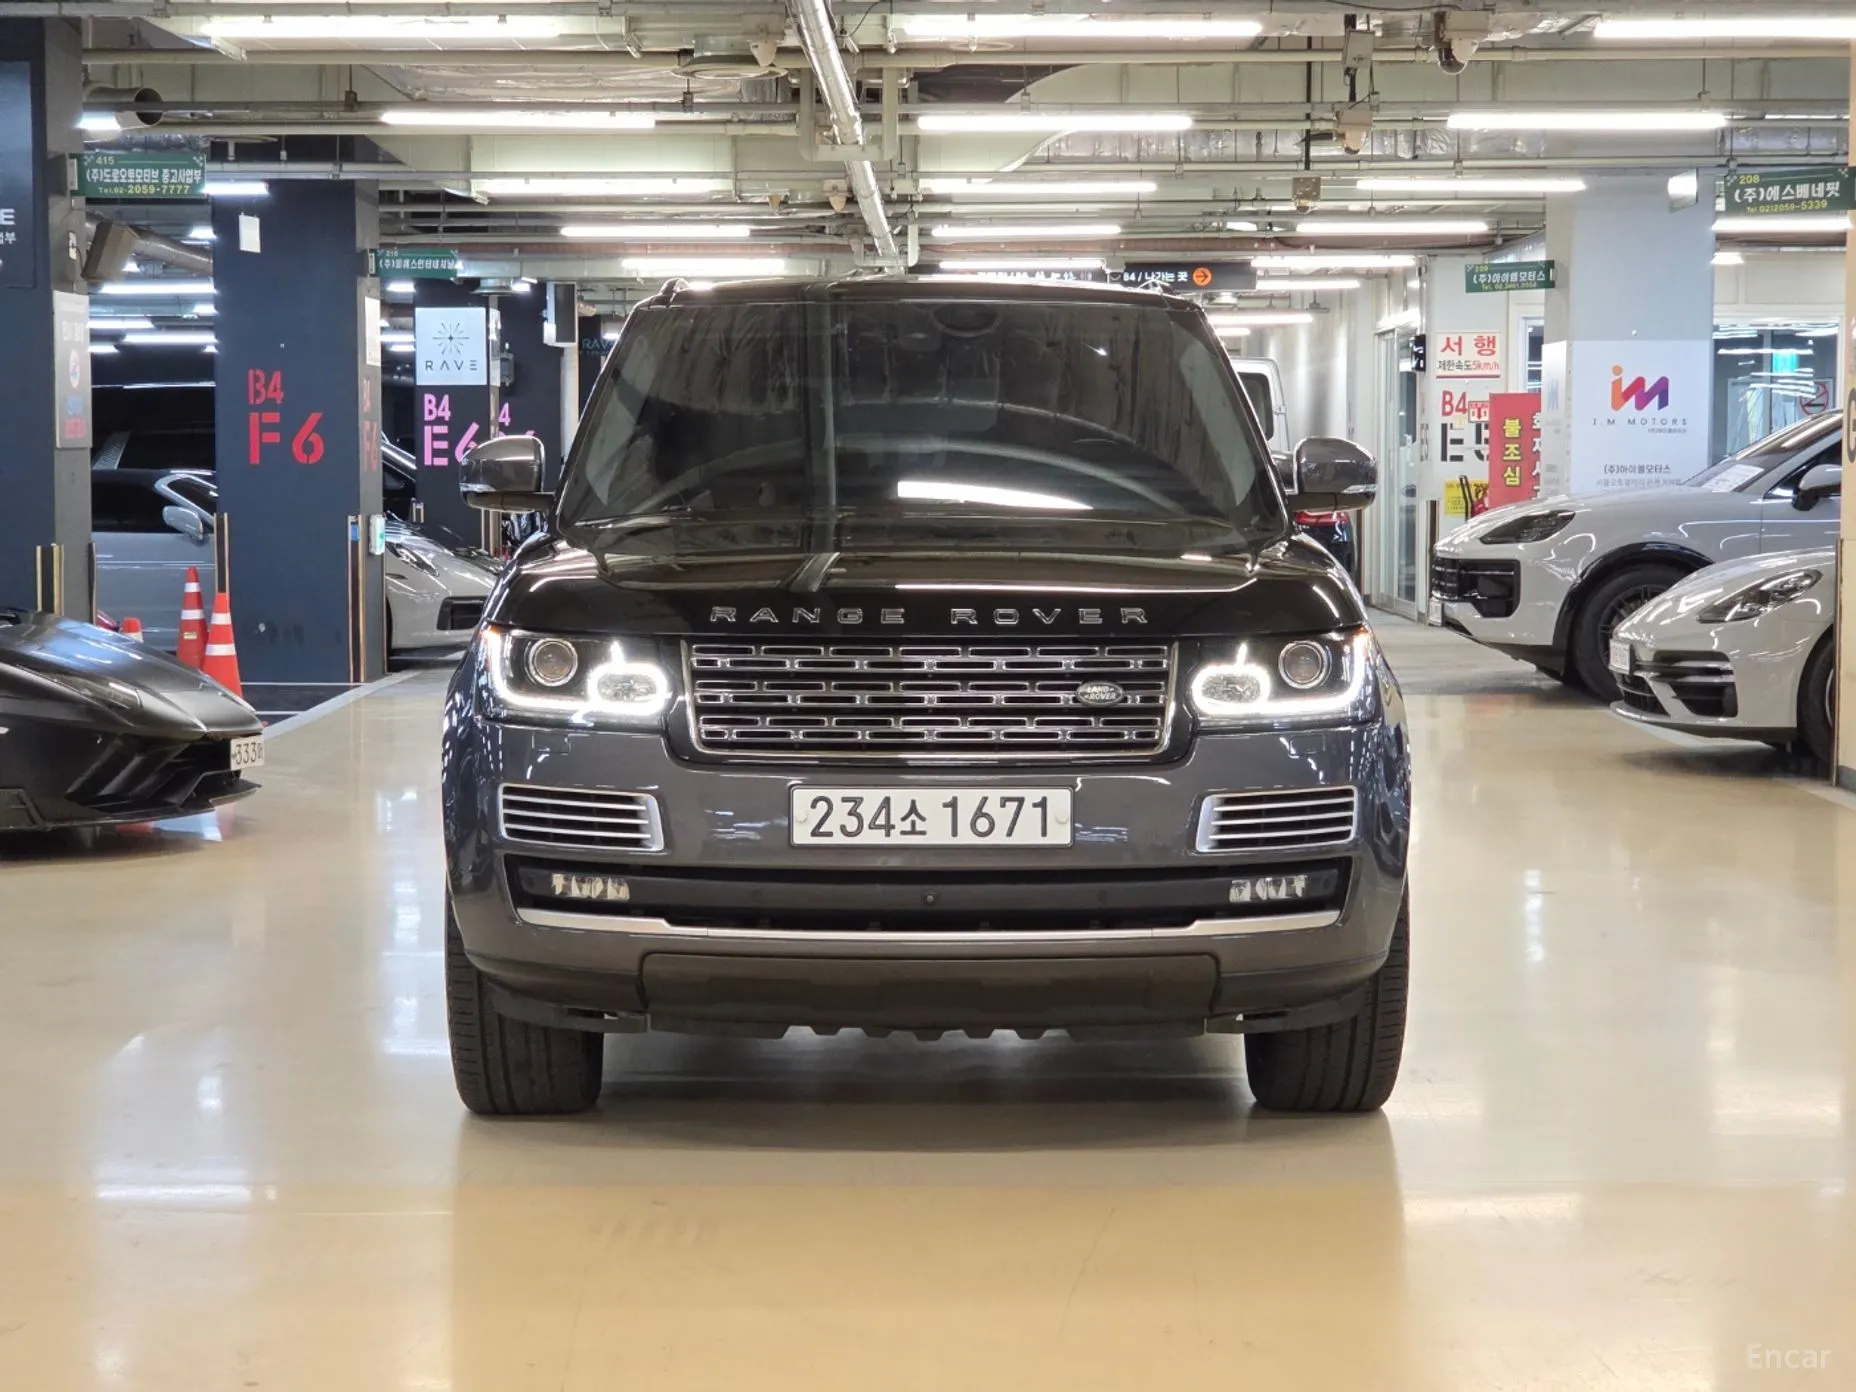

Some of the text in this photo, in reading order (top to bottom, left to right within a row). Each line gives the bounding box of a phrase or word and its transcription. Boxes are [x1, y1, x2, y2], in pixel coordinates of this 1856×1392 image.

[96, 156, 115, 165] 415
[86, 168, 202, 183] (주)도로오토모티브 중고사업부
[1739, 174, 1760, 184] 208
[1734, 181, 1840, 203] (주)에스베네핏
[1123, 272, 1136, 281] B4
[1144, 271, 1175, 282] 나가는
[583, 338, 616, 350] RAV
[425, 360, 478, 371] RAVE
[248, 368, 284, 405] B4
[424, 393, 451, 421] B4
[1441, 390, 1468, 417] B4
[709, 606, 1148, 625] RANGE ROVER
[809, 796, 1049, 838] 234소 1671
